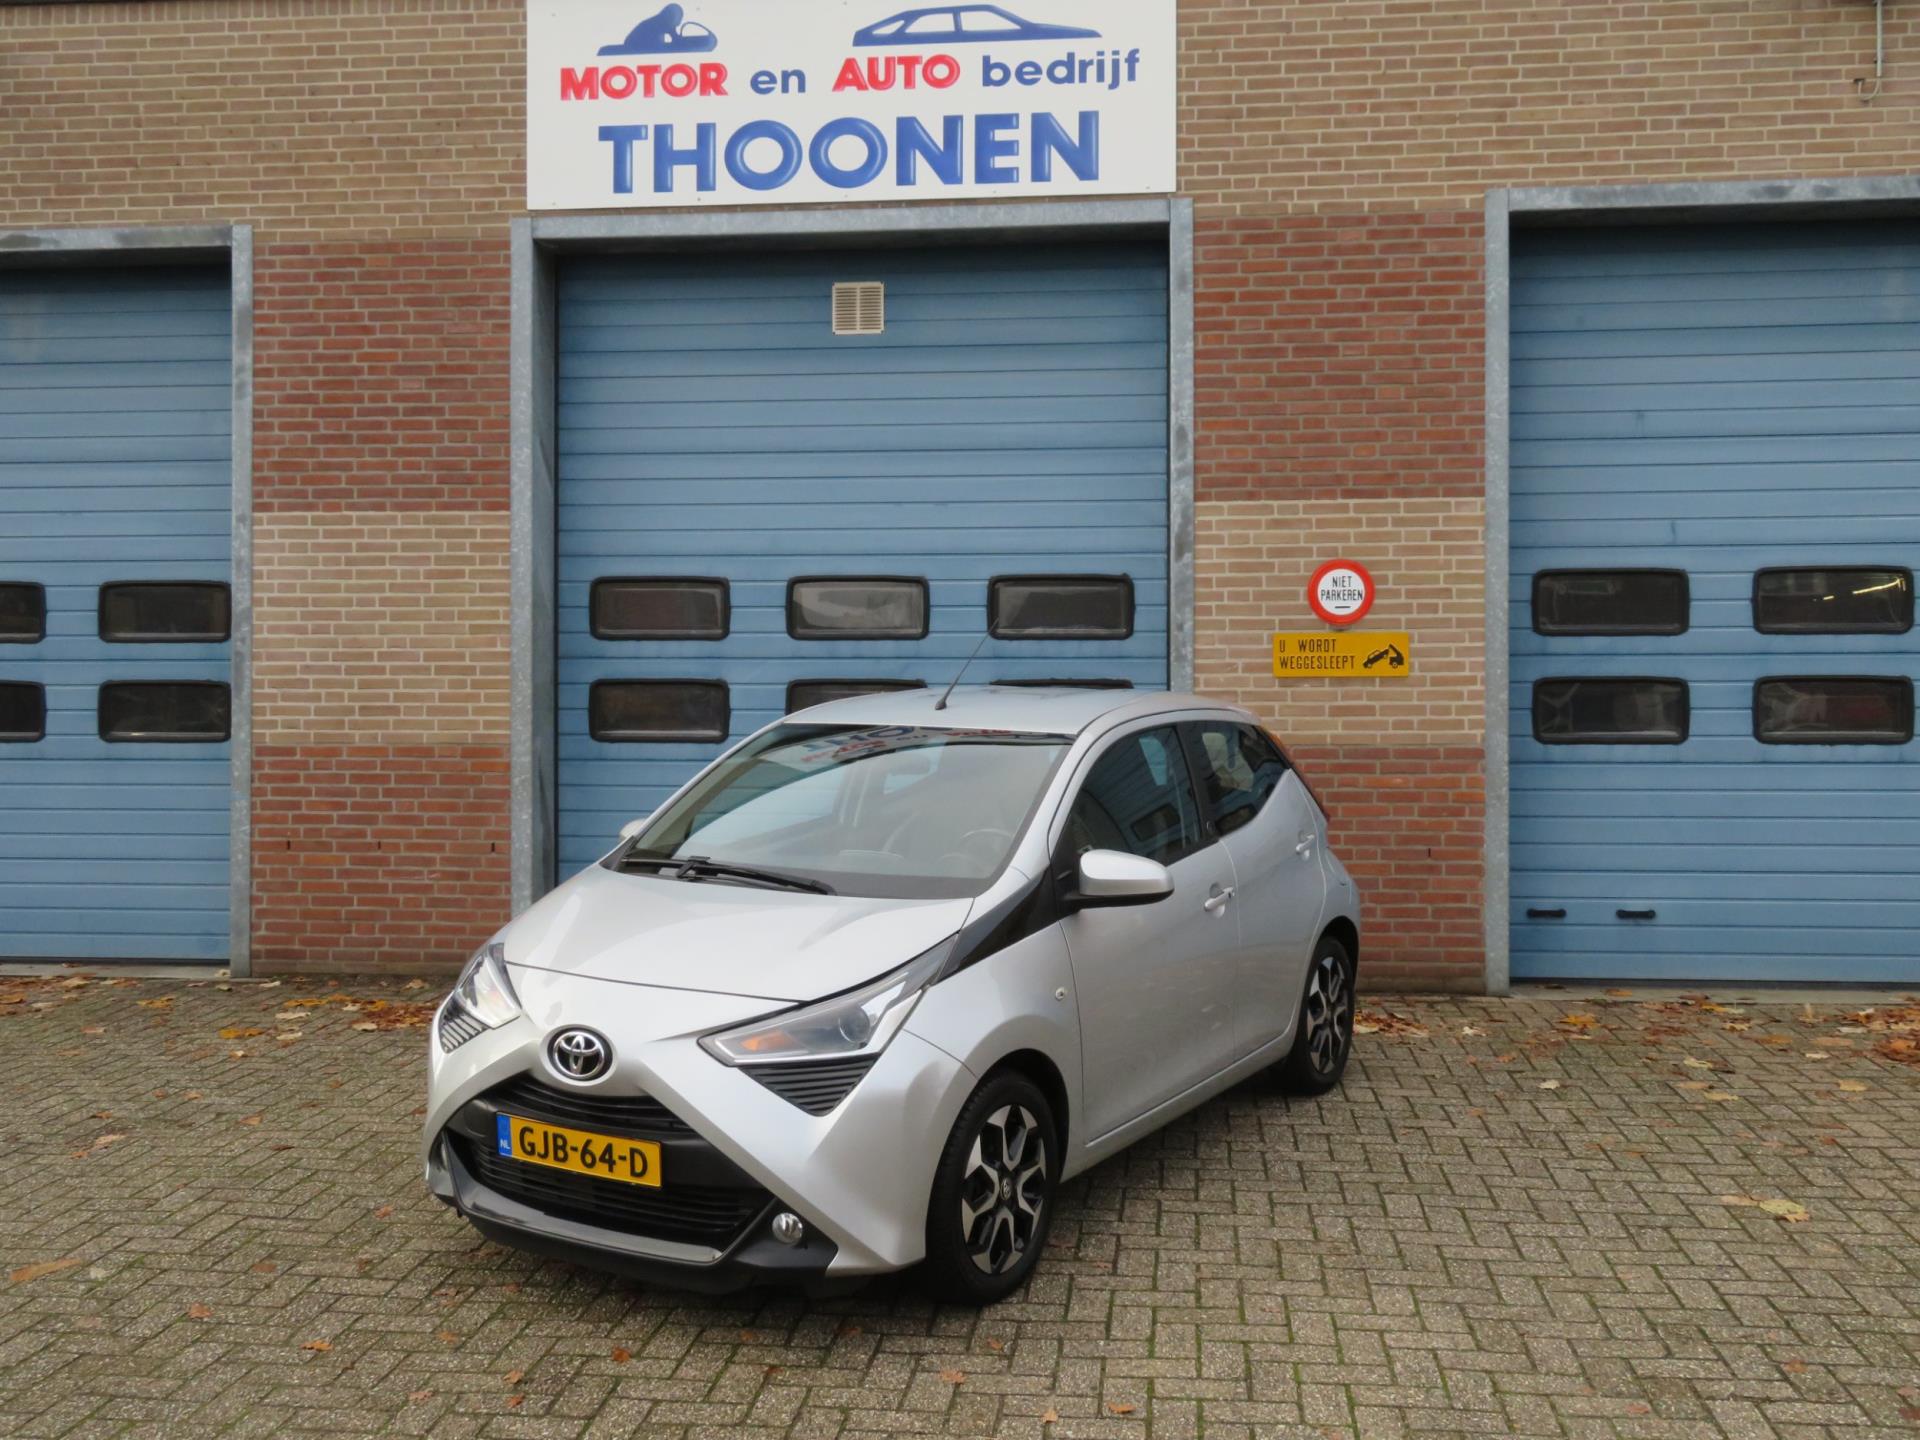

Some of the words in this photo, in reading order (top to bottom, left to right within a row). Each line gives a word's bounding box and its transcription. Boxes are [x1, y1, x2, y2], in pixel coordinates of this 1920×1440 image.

[560, 62, 727, 100] MOTOR
[750, 66, 806, 94] en
[832, 54, 960, 91] AUTO
[982, 49, 1140, 89] bedrijf
[598, 110, 1100, 194] THOONEN
[1332, 576, 1352, 587] NIET
[1320, 589, 1363, 601] PARKEREN
[1279, 639, 1286, 653] U
[1298, 639, 1337, 653] WORDT
[1279, 655, 1356, 670] WEGGESLEEPT
[500, 1138, 511, 1150] NL
[519, 1126, 648, 1178] GJB-64-D
